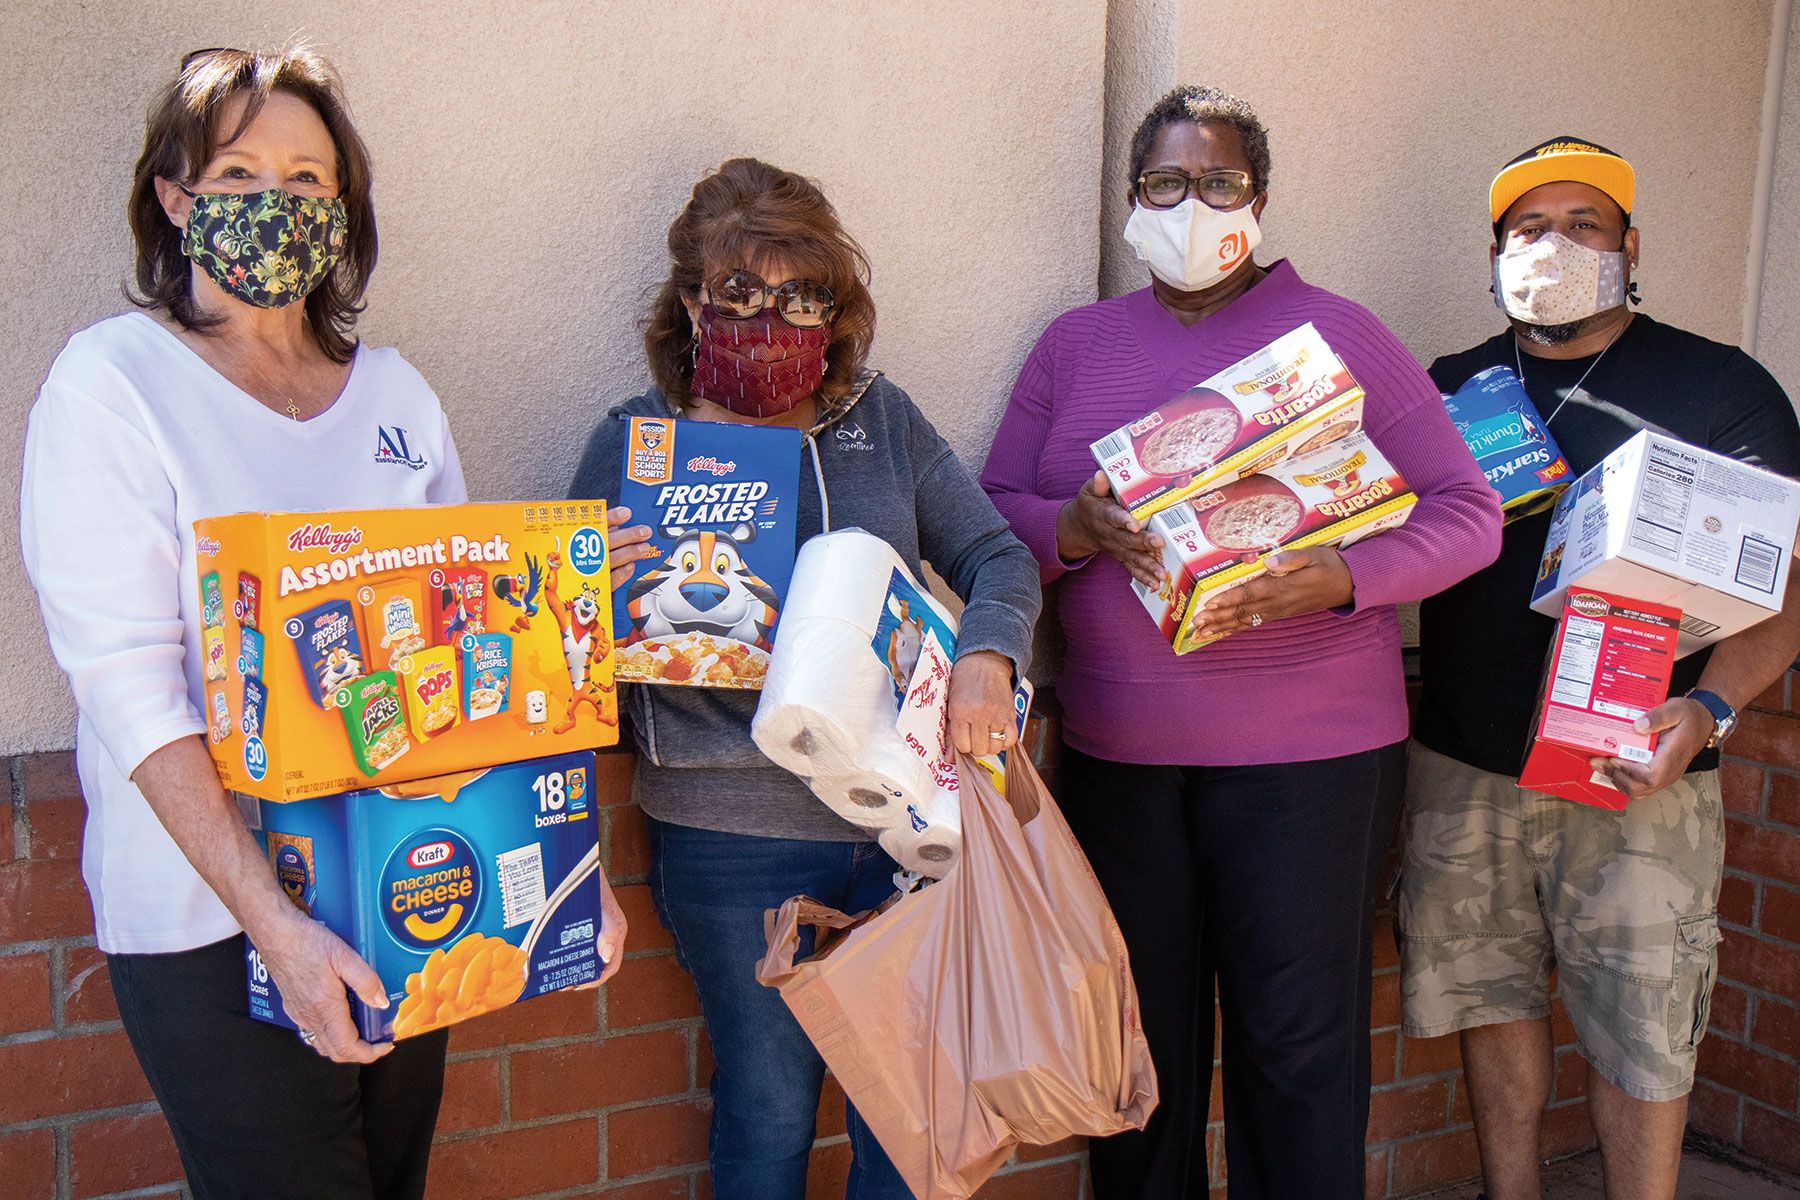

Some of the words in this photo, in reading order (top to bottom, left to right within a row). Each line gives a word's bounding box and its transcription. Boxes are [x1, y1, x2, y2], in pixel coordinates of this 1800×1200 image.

[1248, 357, 1306, 391] TRADITIONAL
[1253, 374, 1337, 426] Rosarita
[639, 425, 666, 433] MISSION
[1471, 428, 1491, 440] TUNA
[1480, 422, 1521, 446] Chunk
[1652, 443, 1679, 458] Nutrition
[1680, 453, 1698, 464] Facts
[634, 469, 666, 479] SPORTS
[635, 461, 666, 470] SCHOOL
[687, 456, 736, 476] Kellogg's
[1107, 457, 1131, 473] CANS
[1309, 457, 1360, 484] TRADITIONAL
[1484, 447, 1550, 483] StarKis
[1119, 469, 1131, 481] 8
[1648, 465, 1675, 479] Calories
[1676, 474, 1693, 485] 280
[656, 481, 769, 506] FROSTED
[1315, 477, 1393, 518] Rosarita
[661, 502, 757, 526] FLAKES
[288, 523, 364, 555] Kellogg's
[1173, 529, 1196, 543] CANS
[574, 533, 601, 559] 30
[1185, 541, 1198, 553] 8
[280, 537, 447, 597] Assortment
[451, 534, 511, 562] Pack
[588, 558, 603, 566] Boxes
[433, 573, 440, 583] 6
[363, 591, 370, 601] 6
[1573, 599, 1608, 610] IDAHOAN
[388, 606, 411, 624] Mini
[290, 622, 298, 634] 9
[312, 615, 348, 645] FROSTED
[317, 625, 347, 651] FLAKES
[466, 638, 473, 647] 3
[484, 649, 502, 660] RICE
[403, 659, 410, 669] 3
[476, 658, 508, 672] KRISPIES
[416, 669, 453, 707] POPS
[340, 692, 347, 703] 3
[366, 696, 389, 717] APPLE
[362, 700, 400, 745] JACKS
[247, 742, 264, 765] 30
[905, 732, 927, 758] IDEA
[531, 772, 565, 813] 18
[535, 812, 567, 828] boxes
[417, 846, 444, 863] Kraft
[506, 863, 518, 873] The
[518, 854, 539, 867] Taste
[392, 867, 461, 894] macaroni
[462, 865, 471, 877] &
[508, 870, 521, 880] You
[522, 864, 540, 876] Love
[423, 907, 445, 917] DINNER
[248, 949, 269, 984] 18
[538, 956, 560, 971] MACARONI
[563, 950, 579, 963] CHEESE
[579, 946, 595, 958] DINNER
[581, 959, 595, 971] BOXES
[250, 979, 269, 996] boxes
[539, 984, 549, 994] NET
